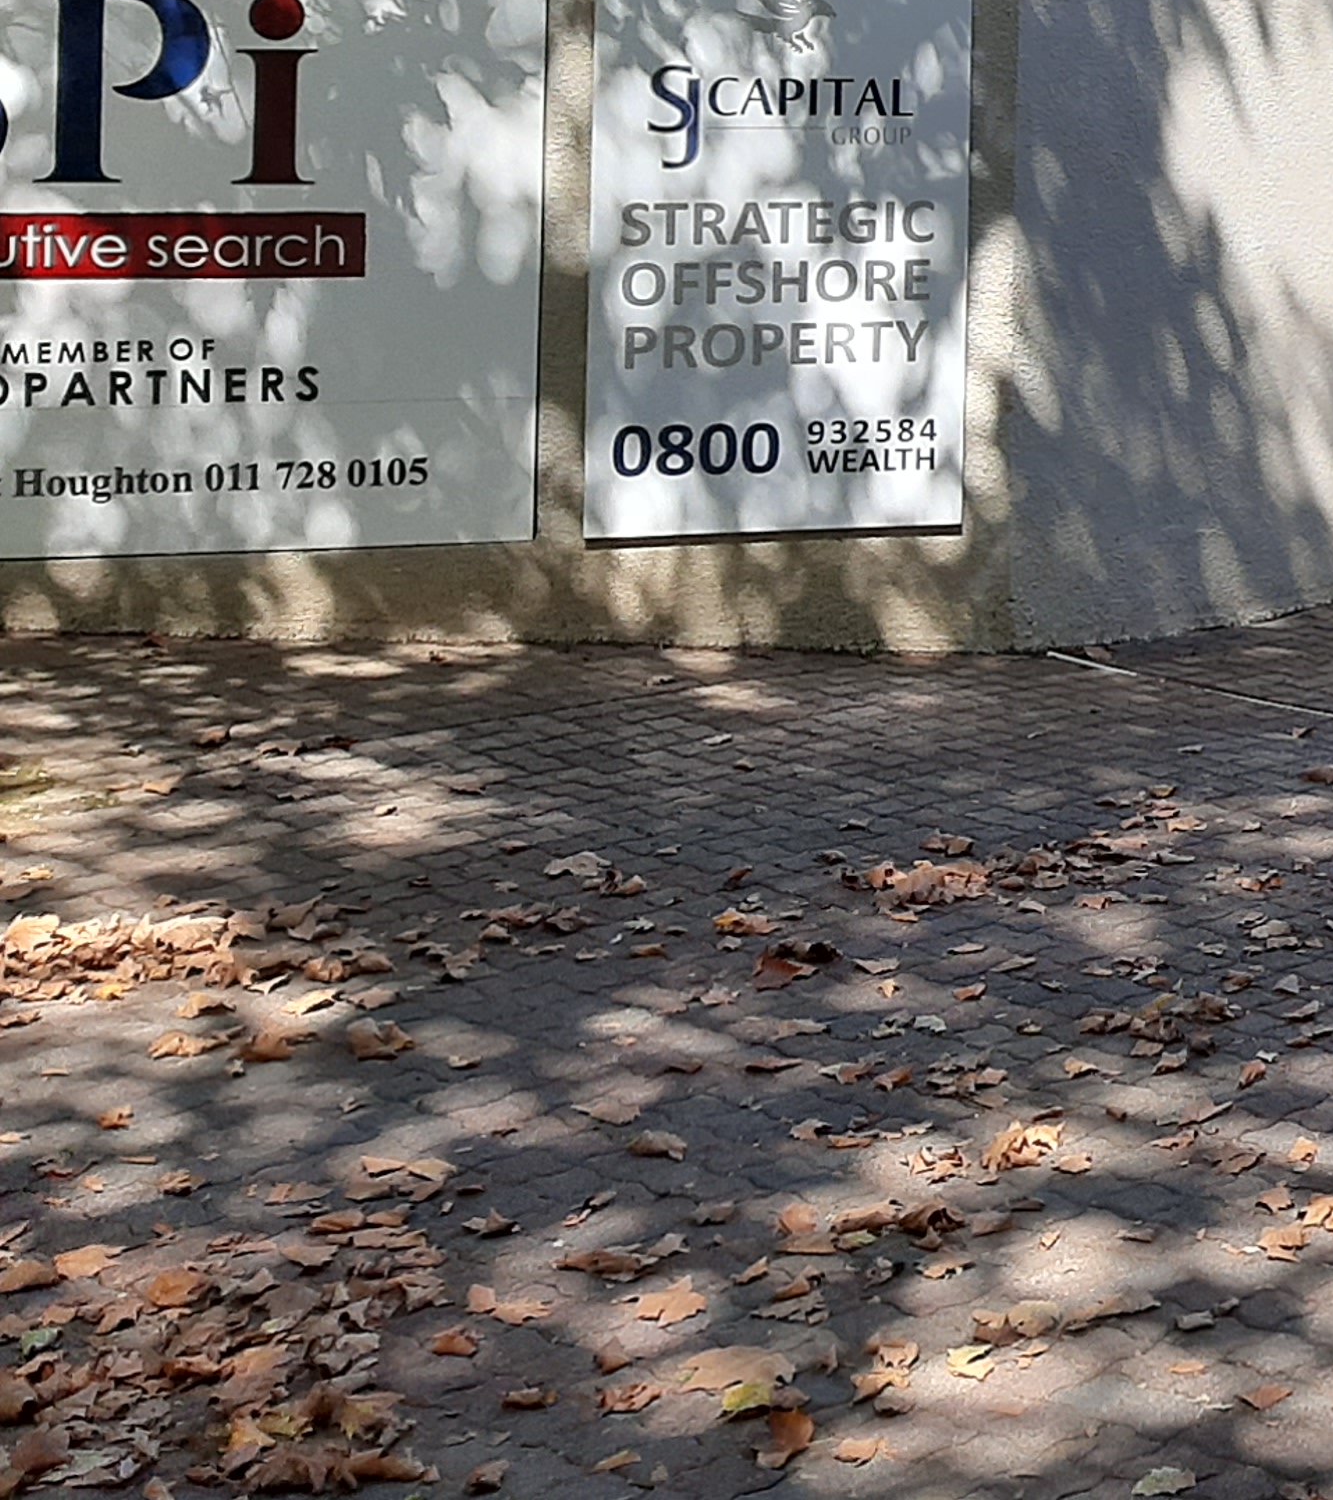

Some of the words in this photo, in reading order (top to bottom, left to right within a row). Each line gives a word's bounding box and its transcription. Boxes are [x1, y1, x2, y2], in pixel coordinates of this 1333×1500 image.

[708, 77, 914, 117] CAPITAL
[831, 126, 912, 146] GROUP
[620, 200, 934, 246] STRATEGIC
[147, 225, 345, 268] search
[621, 259, 930, 306] OFFSHORE
[2, 340, 154, 365] MEMBER
[169, 338, 215, 362] OF
[623, 320, 929, 369] PROPERTY
[0, 366, 319, 407] PARTNERS
[612, 422, 780, 477] 0800
[807, 418, 937, 445] 932584
[807, 447, 935, 473] WEALTH
[13, 467, 193, 503] Houghton
[205, 462, 260, 492] 011
[275, 460, 337, 490] 728
[347, 457, 429, 487] 0105
